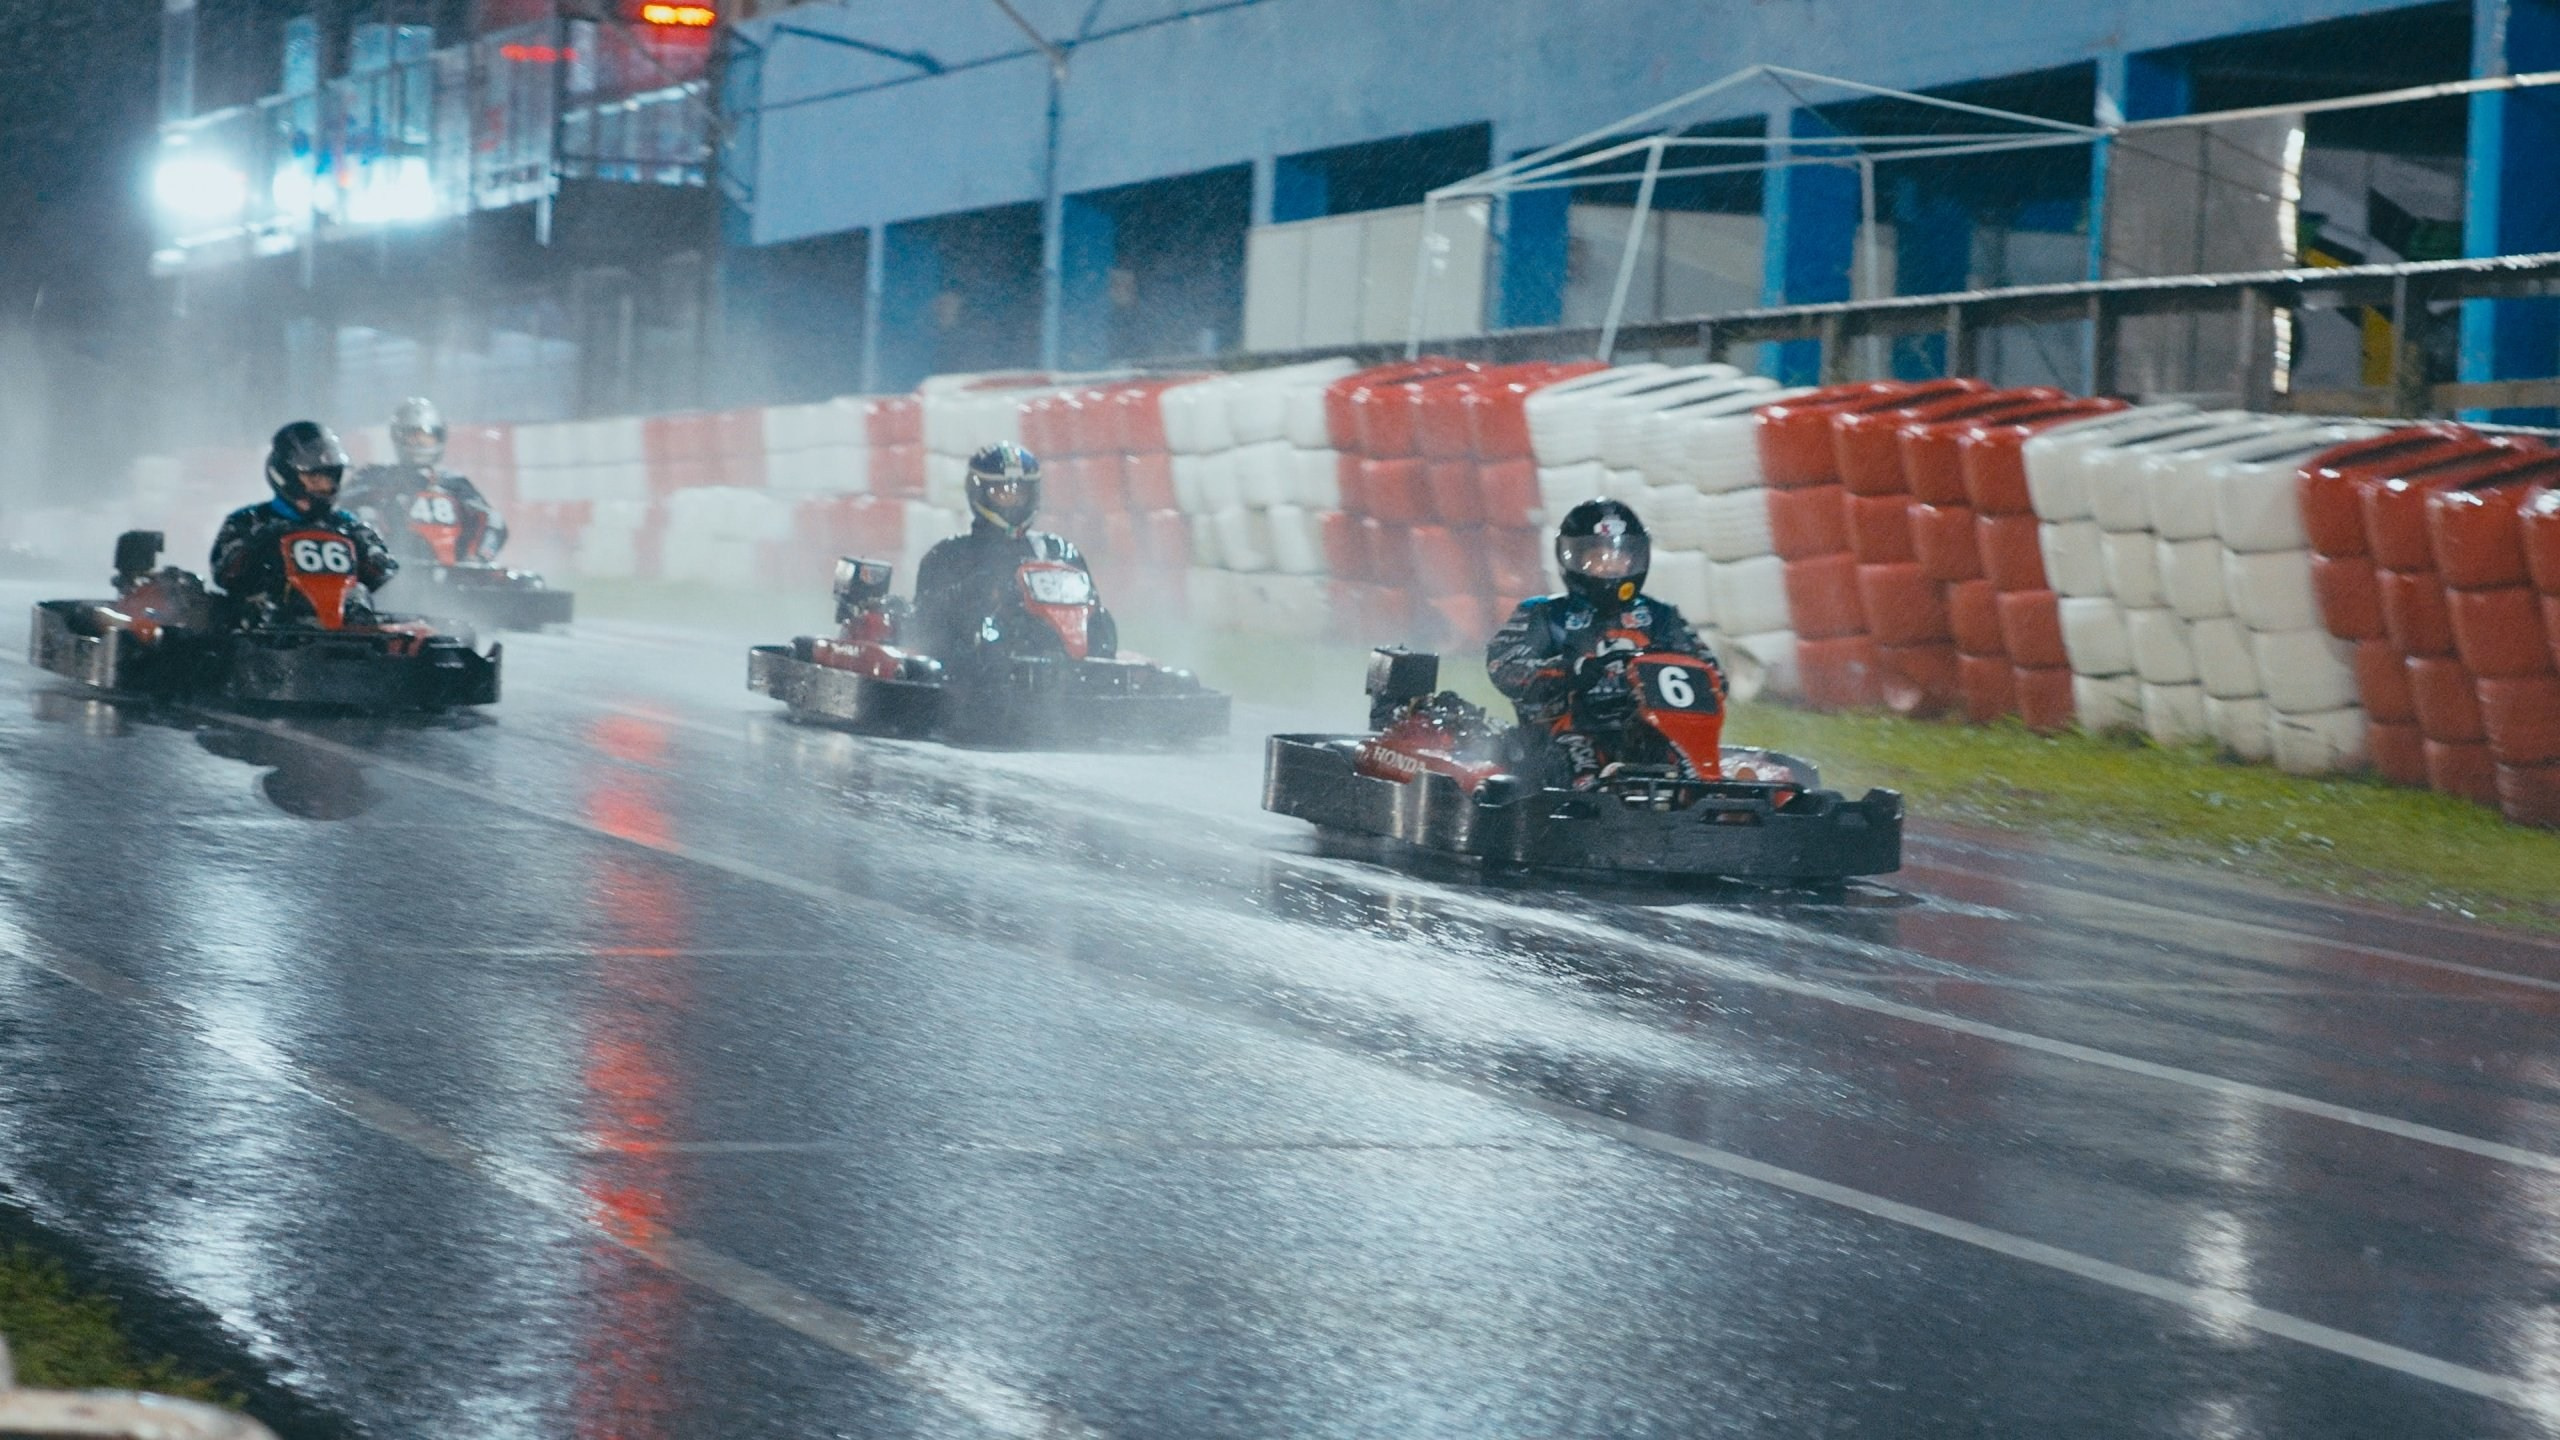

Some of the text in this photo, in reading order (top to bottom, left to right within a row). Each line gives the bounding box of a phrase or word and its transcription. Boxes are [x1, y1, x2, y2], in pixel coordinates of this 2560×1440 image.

[411, 497, 456, 525] 48
[293, 539, 351, 573] 66
[1658, 665, 1695, 708] 6
[1373, 745, 1427, 774] HONDA
